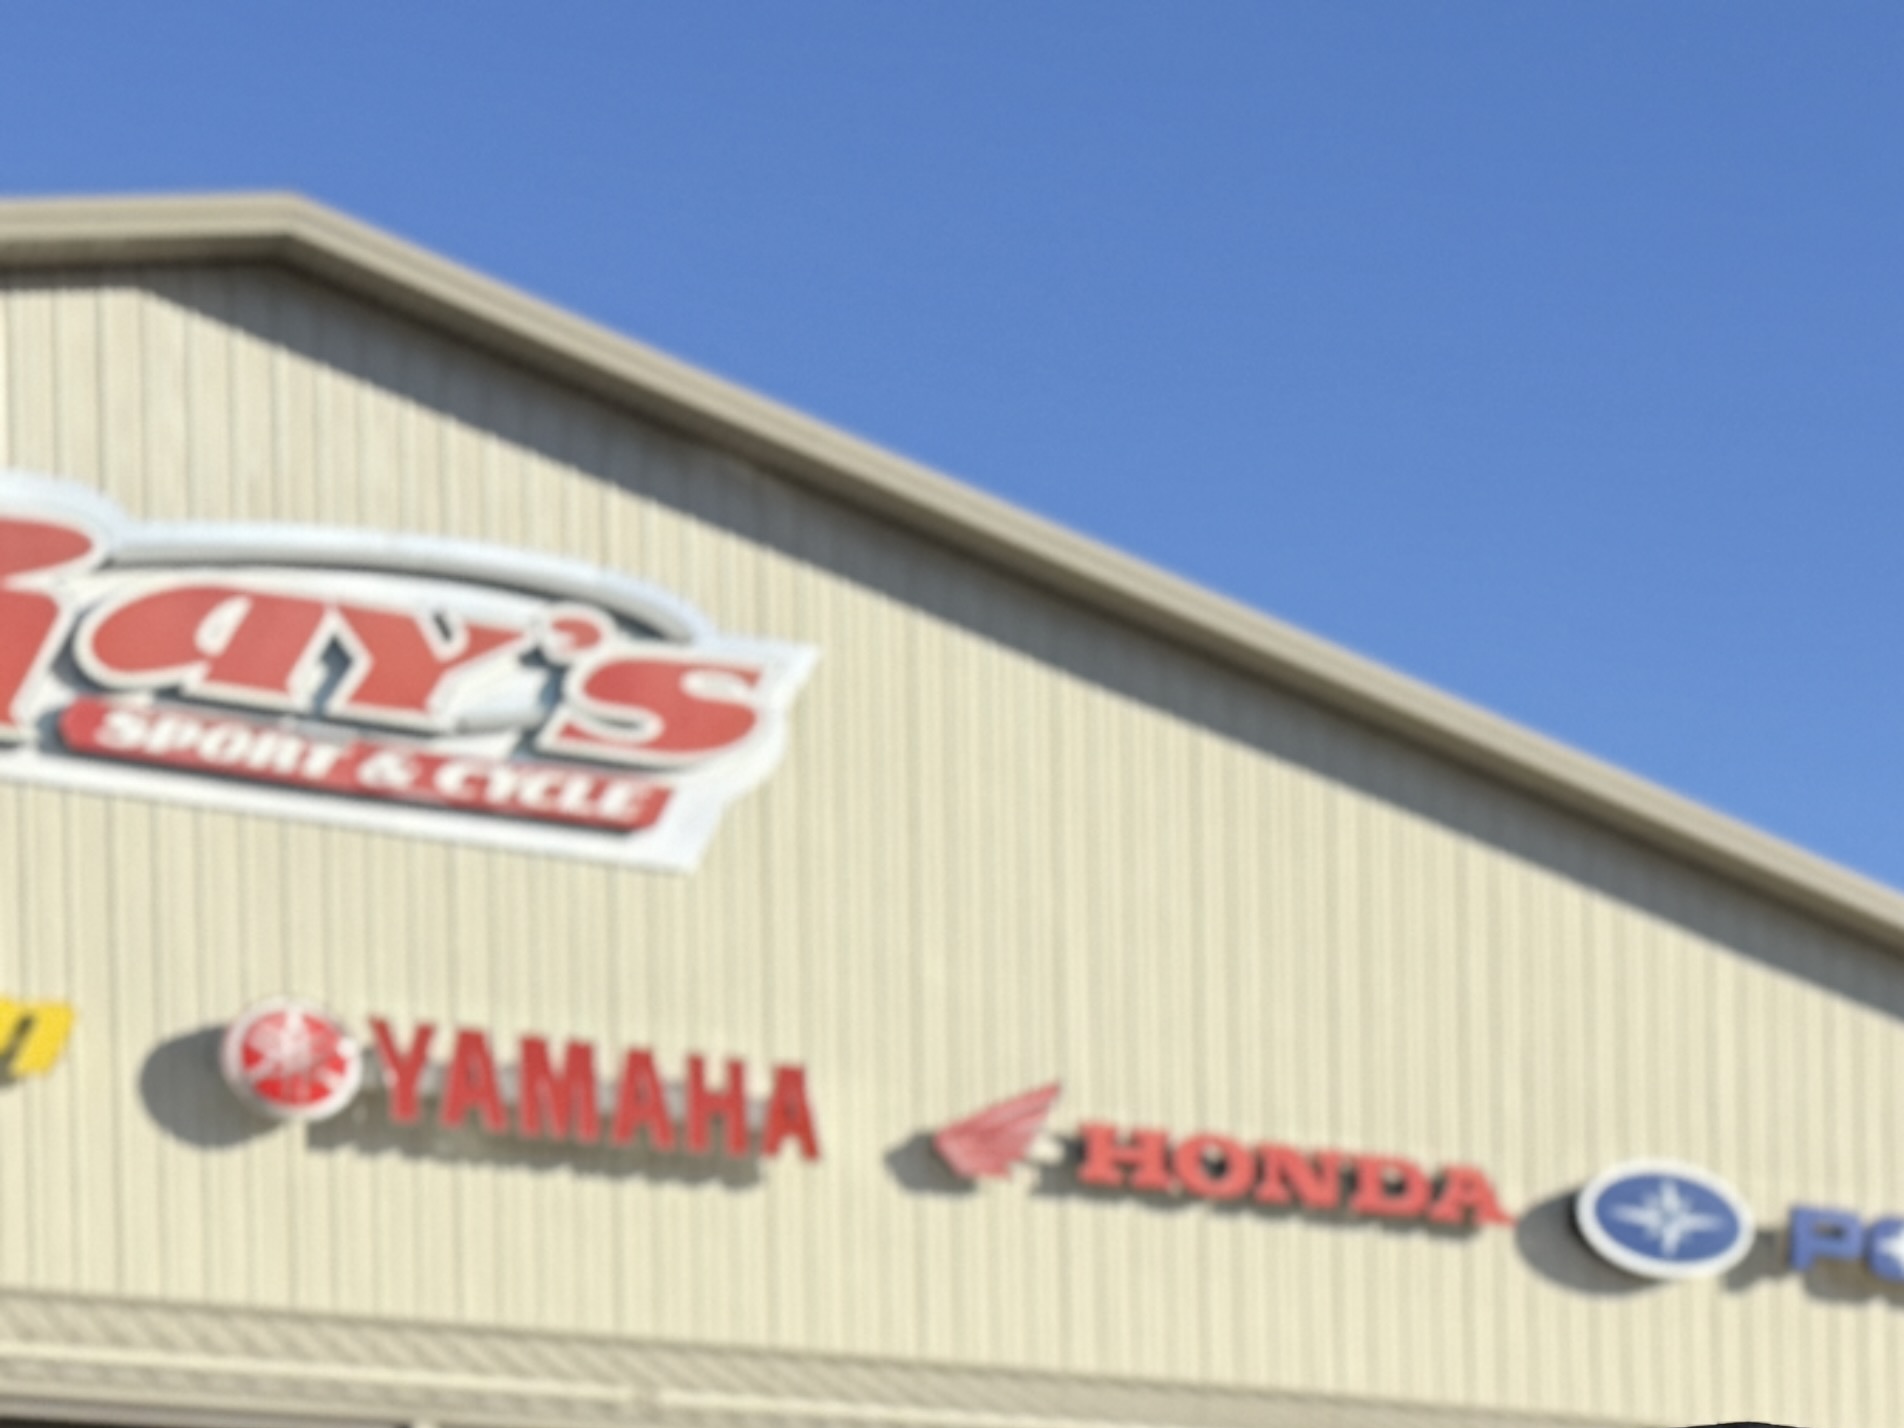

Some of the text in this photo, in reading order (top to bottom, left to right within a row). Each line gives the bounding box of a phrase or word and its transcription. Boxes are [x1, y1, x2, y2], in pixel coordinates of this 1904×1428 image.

[98, 707, 647, 821] SPORT & CYCLE
[369, 1015, 821, 1161] YAMAHA
[1075, 1123, 1518, 1227] HONDA
